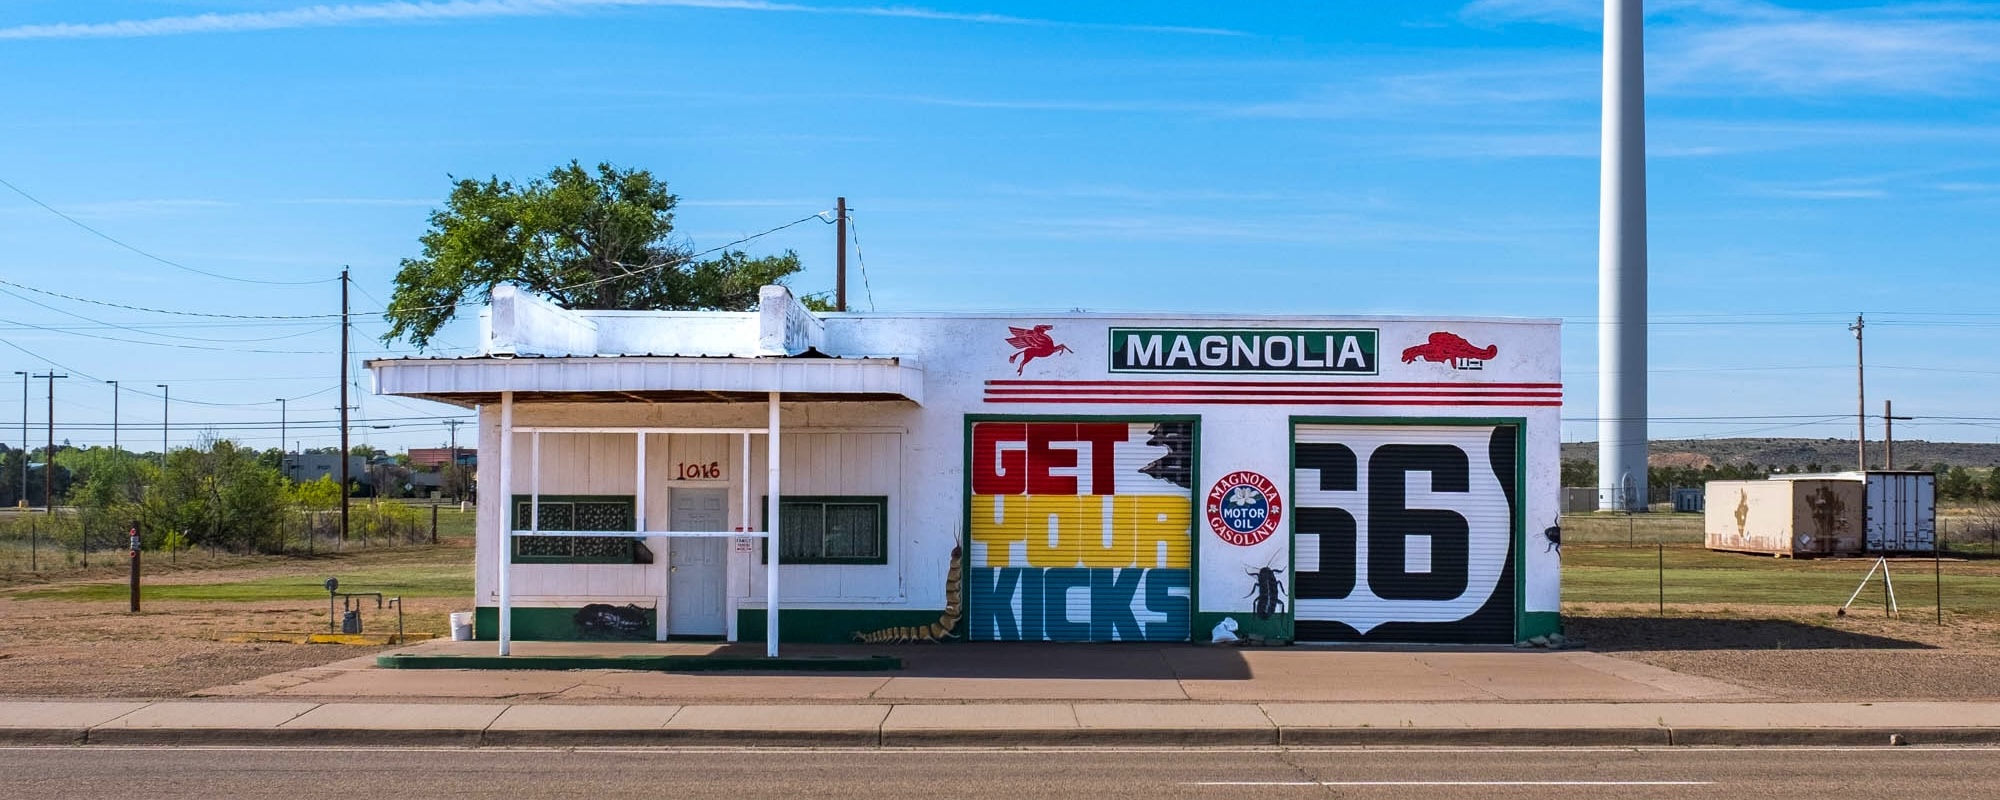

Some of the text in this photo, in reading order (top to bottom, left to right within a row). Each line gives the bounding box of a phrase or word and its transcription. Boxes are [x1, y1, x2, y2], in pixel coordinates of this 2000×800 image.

[1126, 334, 1366, 368] MAGNOLIA
[973, 422, 1129, 495] GET
[1210, 473, 1277, 502] MAGNOLIA
[1223, 508, 1265, 518] MOTOR
[1234, 519, 1254, 528] OIL
[1295, 443, 1469, 601] 66
[971, 495, 1191, 568] YOUR
[1211, 517, 1277, 545] GASOLINE
[970, 567, 1191, 641] KICKS
